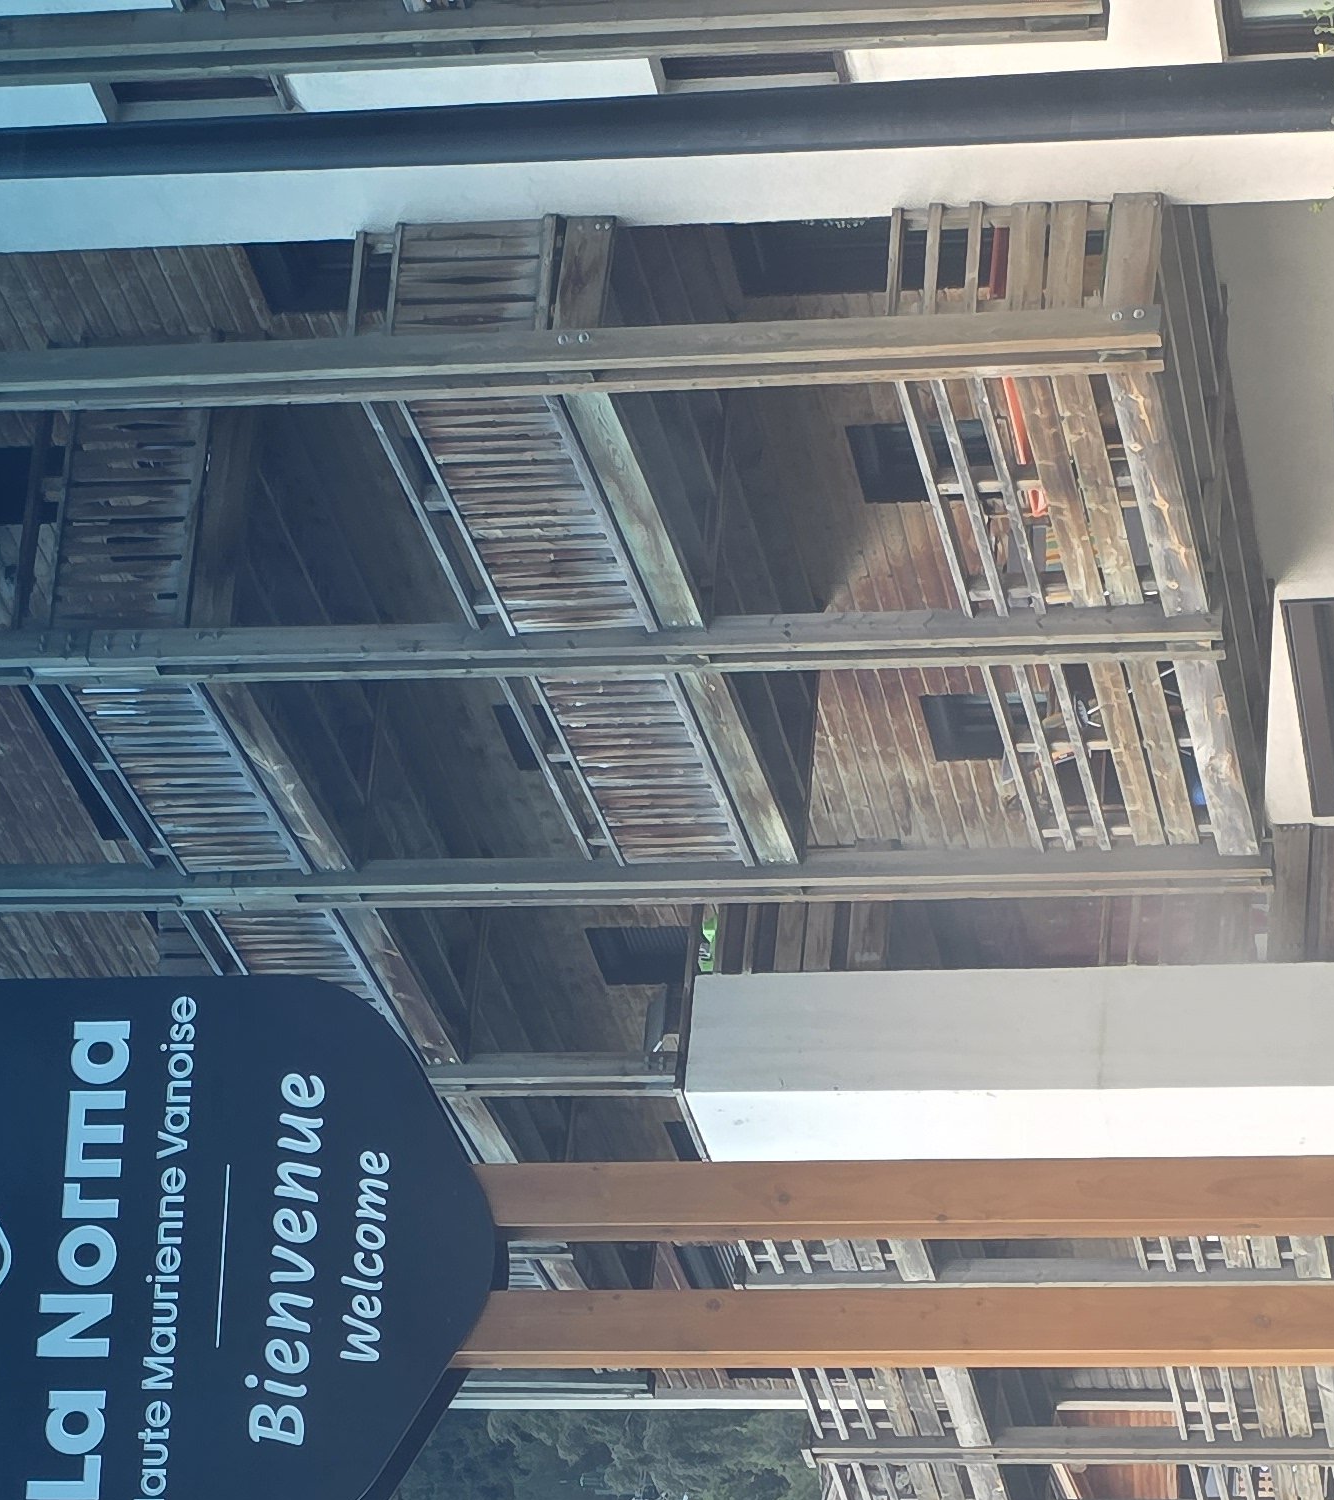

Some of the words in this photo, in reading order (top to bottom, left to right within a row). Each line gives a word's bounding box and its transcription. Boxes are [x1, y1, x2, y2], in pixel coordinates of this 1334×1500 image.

[156, 995, 197, 1160] Vanoise
[35, 1020, 131, 1358] Norma
[141, 1166, 187, 1390] Maurienne
[244, 1073, 326, 1446] Bienvenue
[339, 1150, 390, 1362] Welcome
[25, 1389, 107, 1500] La
